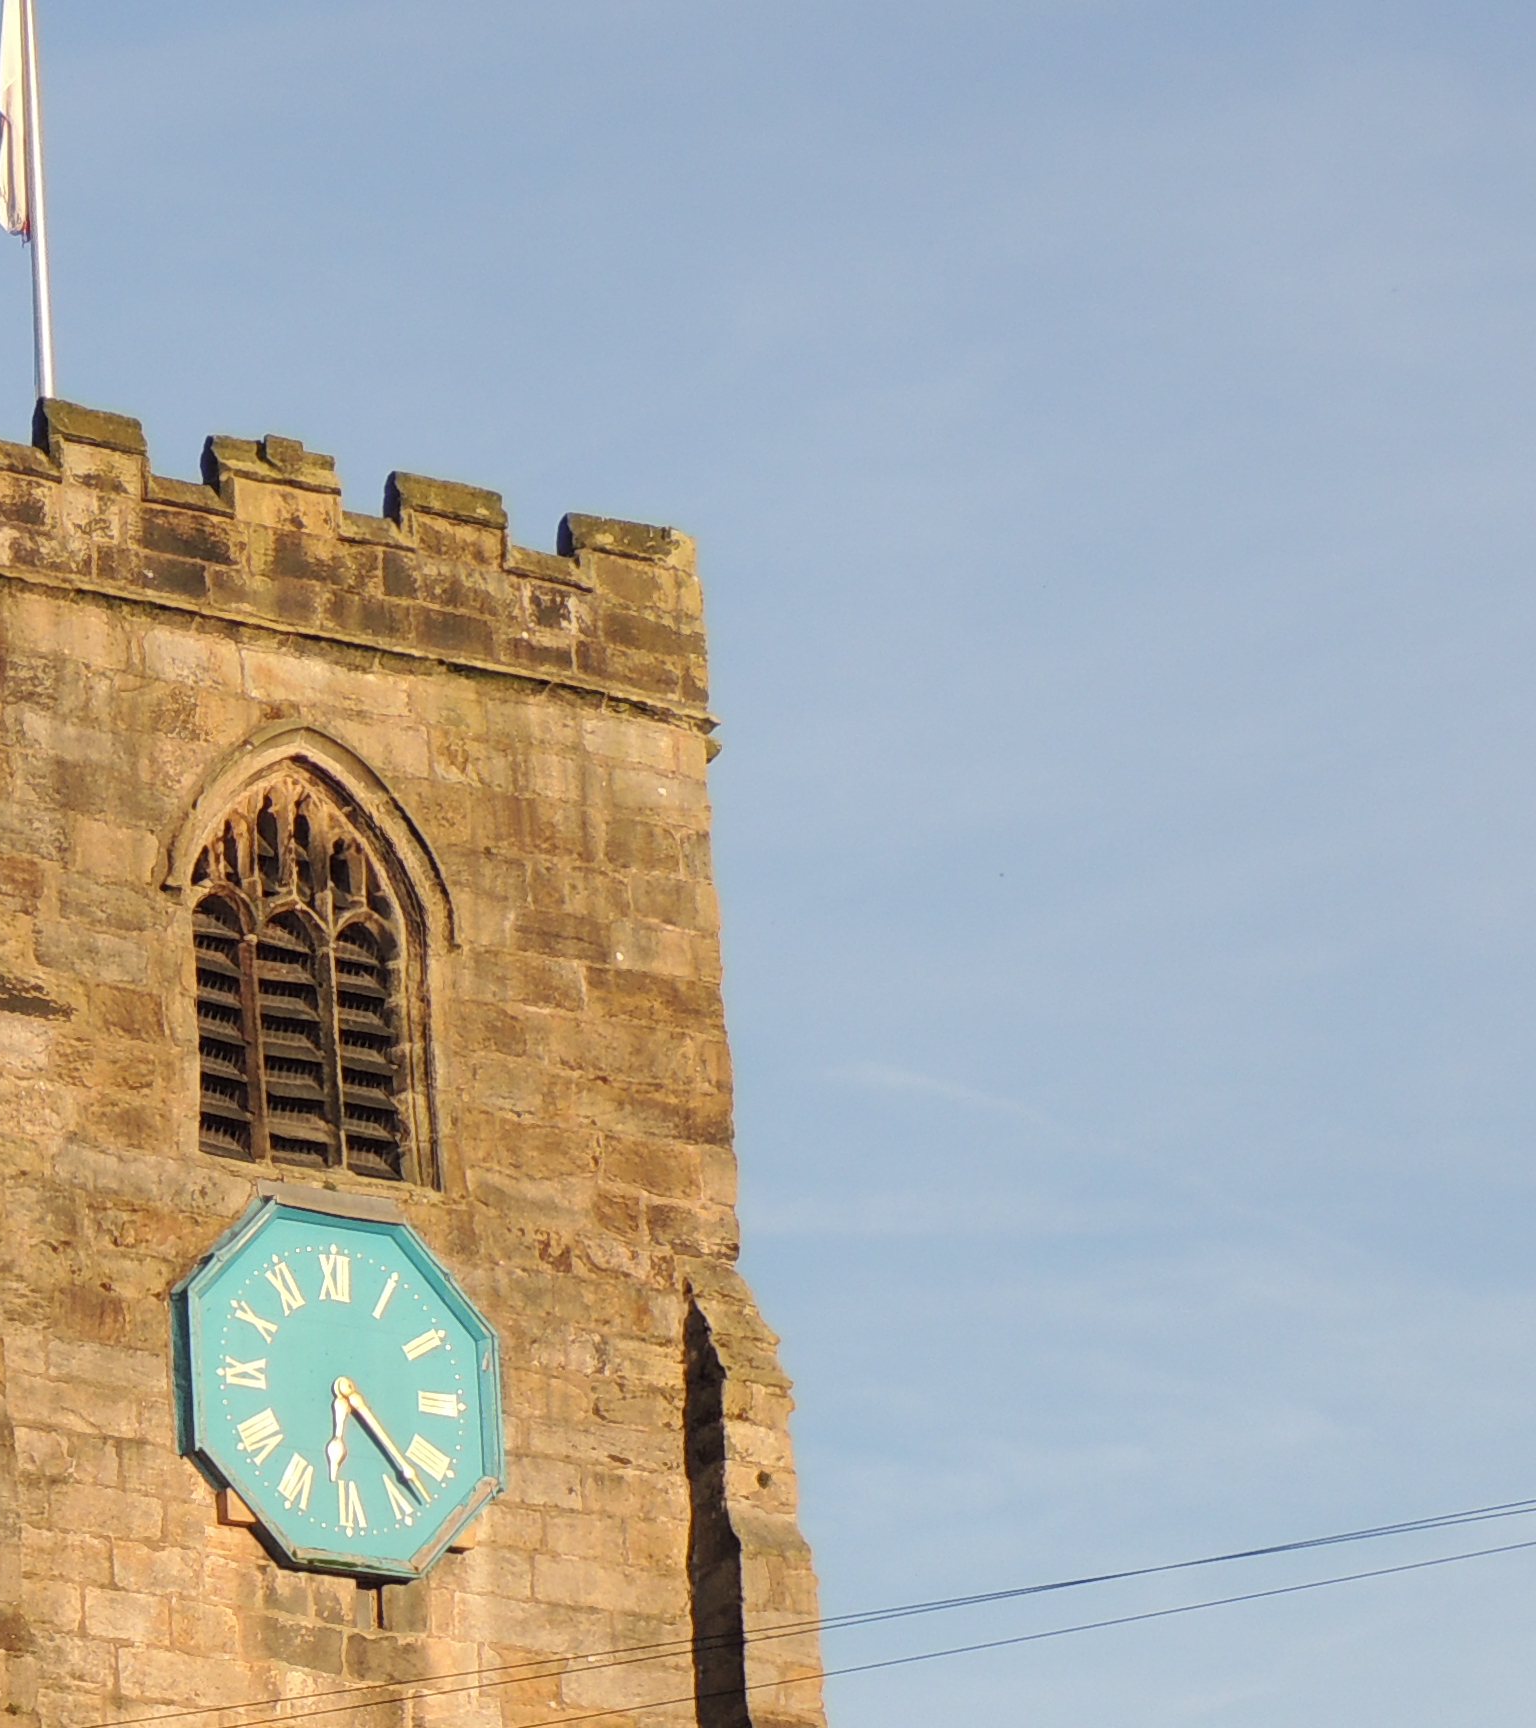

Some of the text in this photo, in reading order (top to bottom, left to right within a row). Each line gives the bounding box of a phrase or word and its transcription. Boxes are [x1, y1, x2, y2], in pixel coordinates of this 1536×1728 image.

[265, 1262, 305, 1316] XI
[319, 1254, 351, 1303] XII
[372, 1277, 396, 1319] I
[235, 1301, 277, 1343] X
[402, 1328, 442, 1361] II
[225, 1356, 267, 1389] IX
[418, 1390, 458, 1417] III
[236, 1407, 284, 1466] VIII
[277, 1452, 314, 1510] VII
[339, 1479, 367, 1528] VI
[383, 1474, 414, 1520] V
